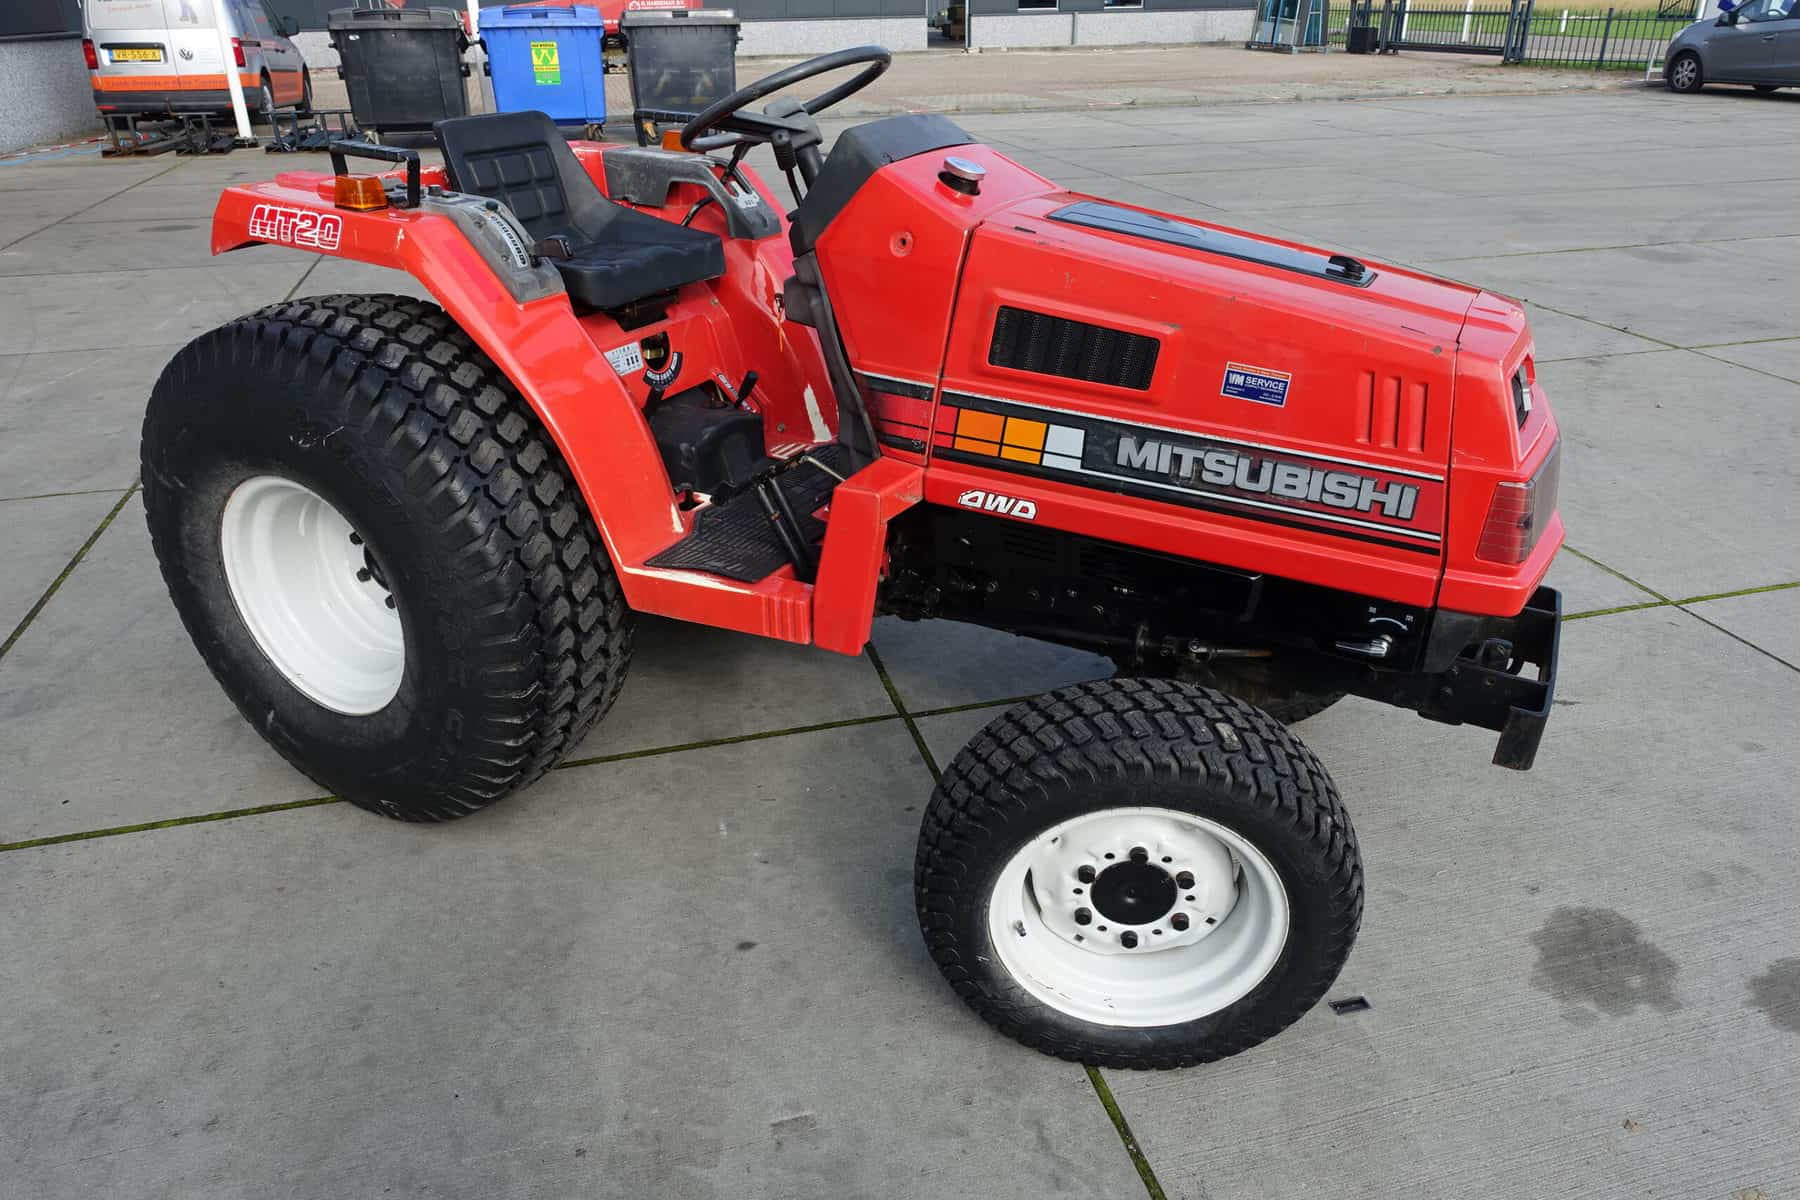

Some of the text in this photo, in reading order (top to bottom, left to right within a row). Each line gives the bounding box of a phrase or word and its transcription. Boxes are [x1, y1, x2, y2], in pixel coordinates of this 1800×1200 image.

[249, 204, 342, 249] MT20
[1245, 376, 1285, 390] SERVICE
[1116, 437, 1419, 520] MITSUBISHI
